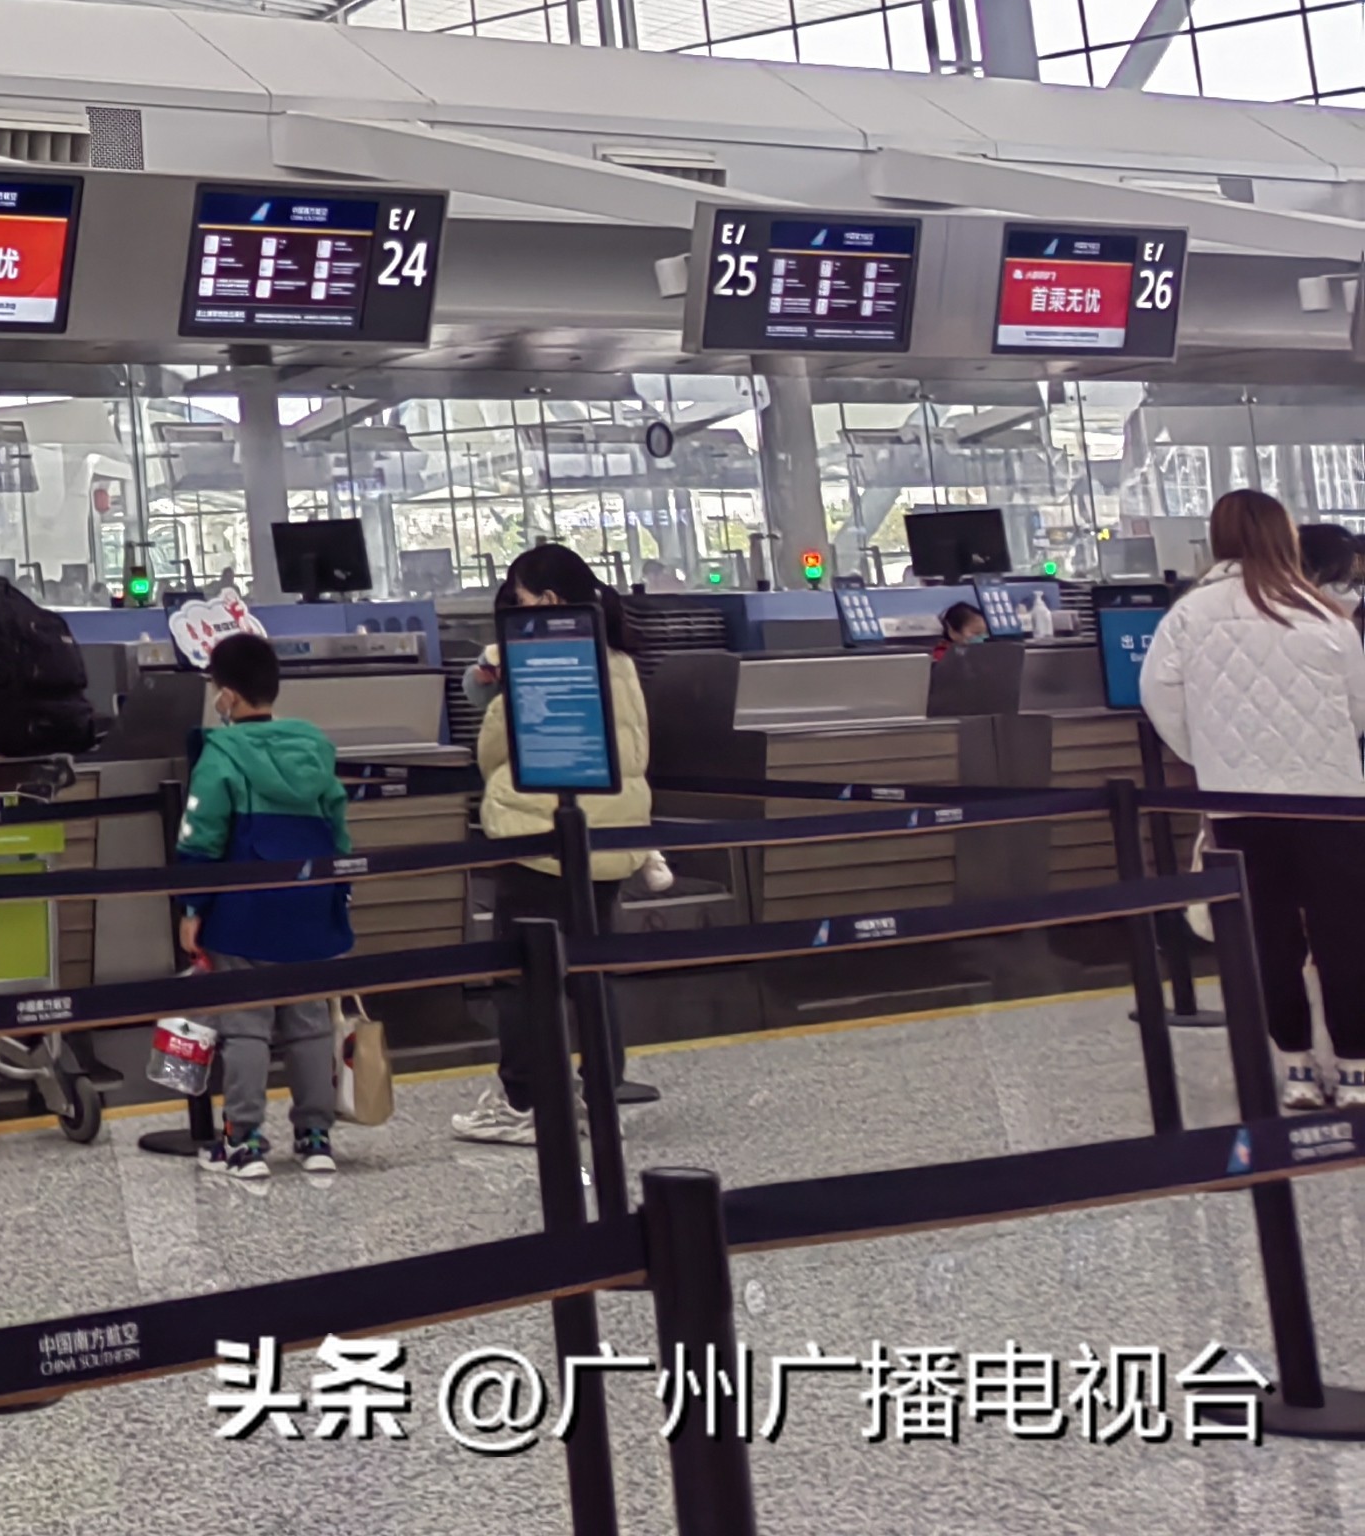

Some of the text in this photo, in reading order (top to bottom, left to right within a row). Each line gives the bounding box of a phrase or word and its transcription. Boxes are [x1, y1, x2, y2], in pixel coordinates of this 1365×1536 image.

[377, 240, 428, 287] 24
[713, 253, 759, 296] 25
[1030, 286, 1102, 314] 首乘无忧
[1135, 269, 1174, 310] 26
[38, 1321, 139, 1356] 中国南方航空
